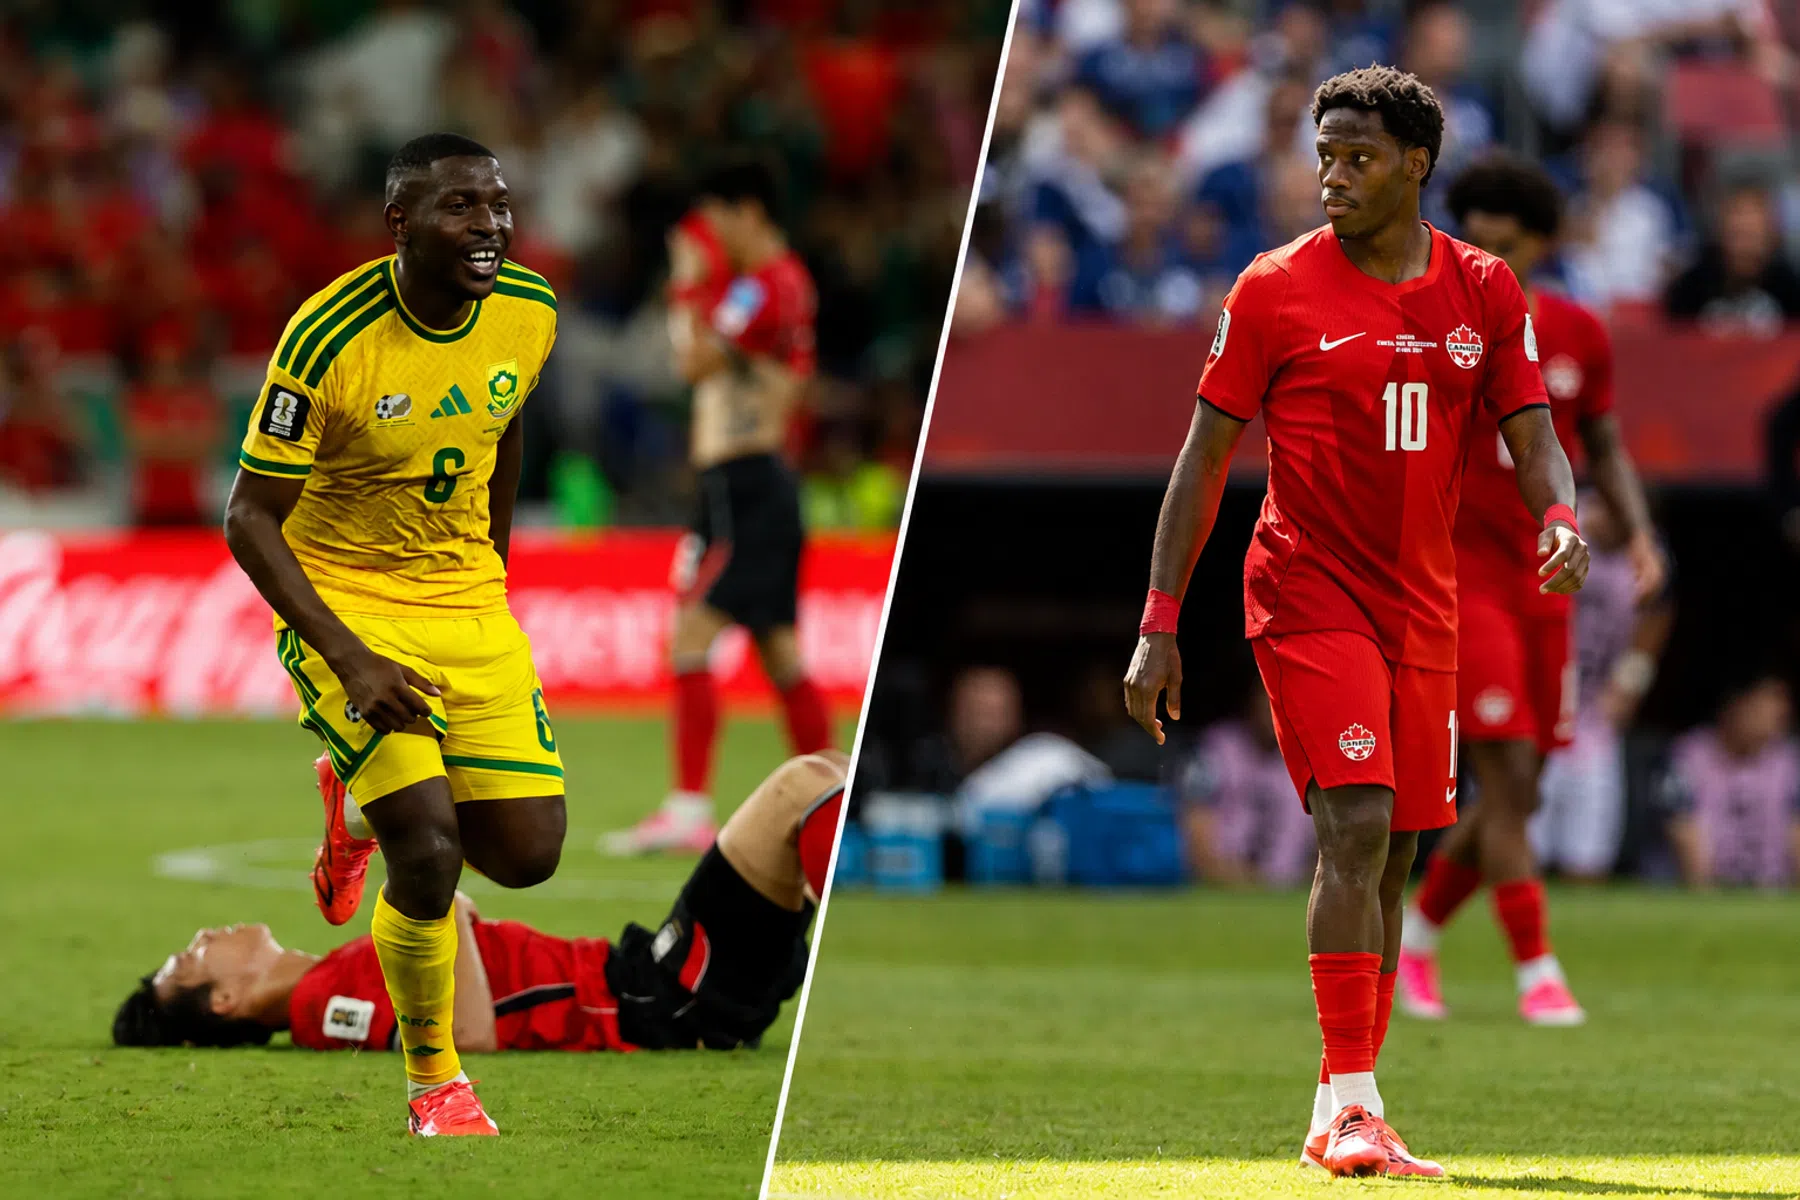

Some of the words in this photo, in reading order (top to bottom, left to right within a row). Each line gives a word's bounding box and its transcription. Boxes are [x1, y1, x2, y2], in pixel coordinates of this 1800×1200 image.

[1382, 381, 1429, 451] 10
[424, 447, 465, 504] 6
[532, 688, 557, 753] 6
[1447, 710, 1459, 778] 1
